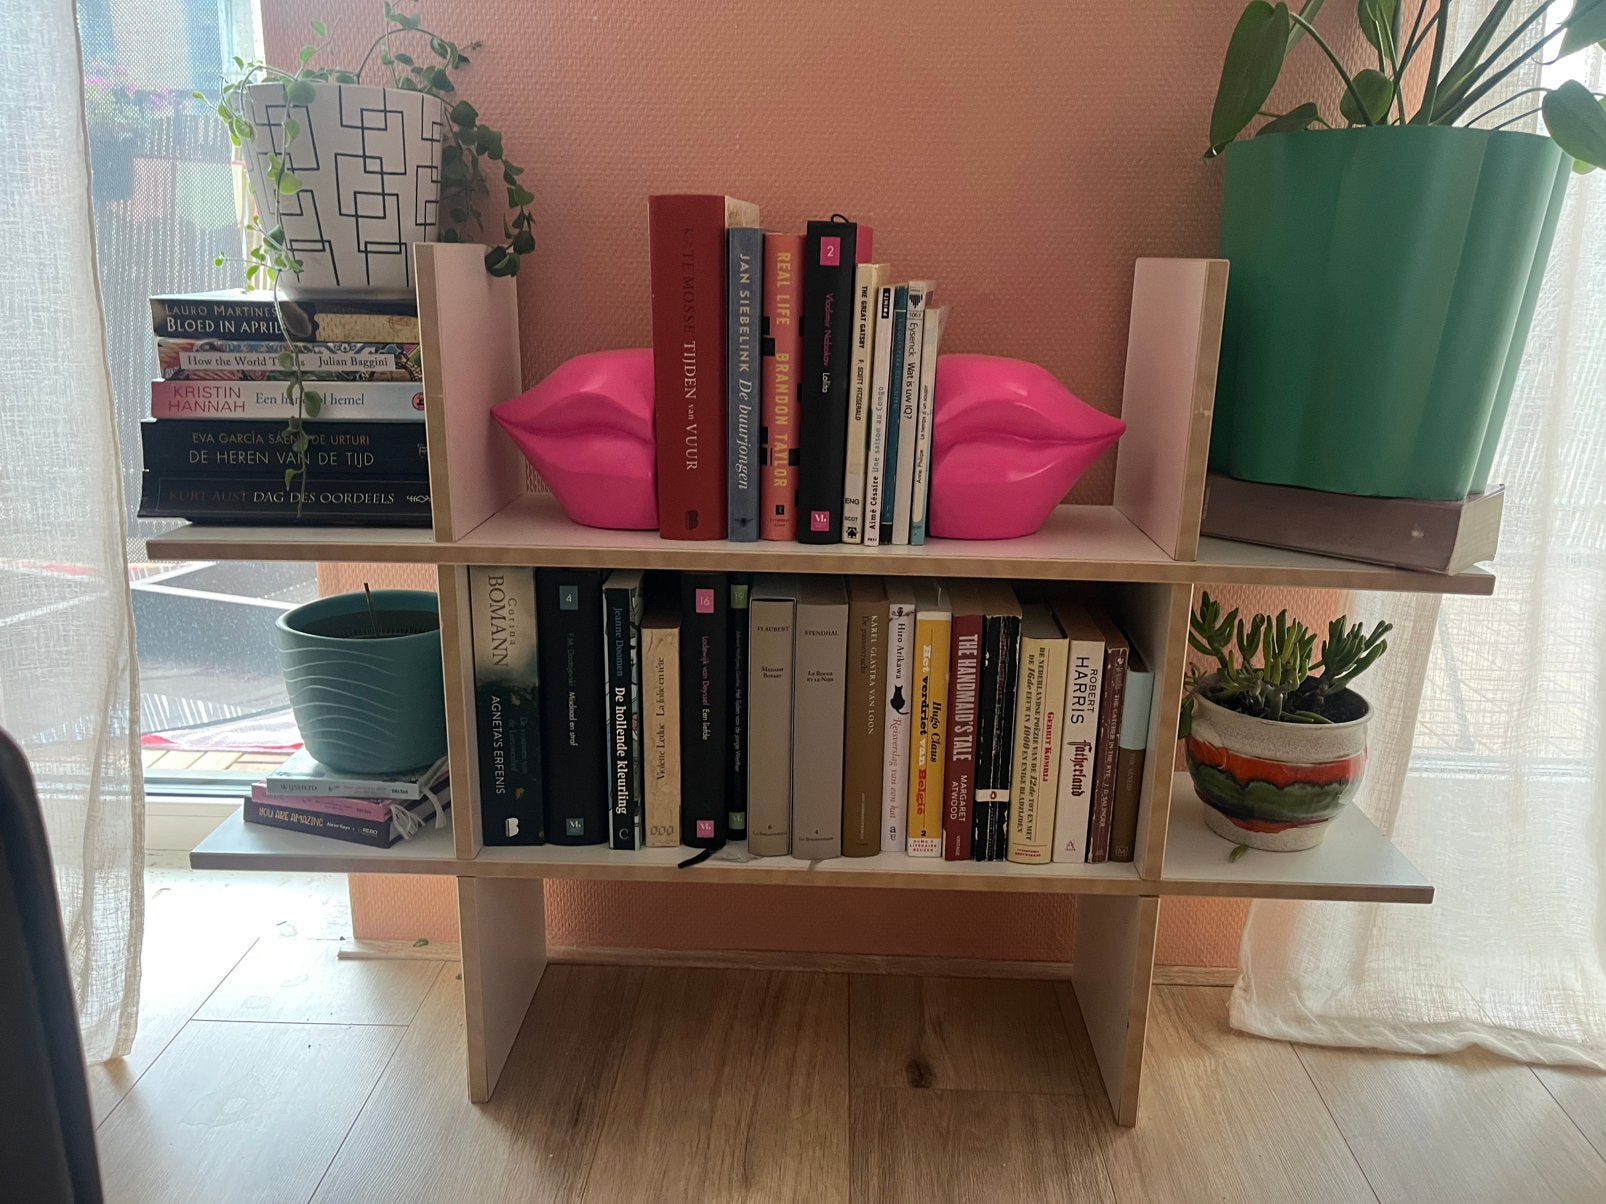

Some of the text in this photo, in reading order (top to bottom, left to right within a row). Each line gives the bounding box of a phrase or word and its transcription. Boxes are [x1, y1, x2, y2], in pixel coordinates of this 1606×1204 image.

[827, 245, 835, 257] 2
[776, 252, 792, 326] REAL LIFE
[165, 304, 207, 316] LAURO
[739, 253, 751, 372] JAN SIEBELINK
[858, 286, 869, 349] THE GREAT GATSBY
[166, 317, 282, 335] BLOED IN APRIL
[908, 322, 919, 357] Eysenck
[188, 355, 206, 367] How
[215, 355, 232, 366] the
[234, 356, 267, 367] World
[318, 356, 348, 369] Julian
[350, 357, 389, 370] Baggini
[906, 362, 916, 379] Wat
[173, 386, 242, 399] KRISTIN
[821, 372, 831, 393] Lolita
[904, 389, 913, 402] uw
[168, 400, 245, 413] HANNAH
[255, 392, 278, 405] Een
[330, 393, 365, 406] hemel
[683, 341, 699, 471] TIJDEN van VUUR
[902, 404, 912, 420] IQ?
[735, 379, 753, 491] De buurjongen
[773, 353, 791, 488] BRANDON TAYLOR
[192, 432, 215, 445] EVA
[218, 431, 265, 445] GARCÍA
[330, 435, 370, 446] URTURI
[189, 450, 375, 468] DE HEREN VAN DE TIJD
[253, 491, 396, 504] DAG DES OORDEELS
[869, 476, 880, 506] Césaire
[869, 509, 878, 530] Aimé
[566, 593, 573, 603] 4
[700, 596, 711, 606] 16
[487, 575, 509, 667] BOMANN
[612, 607, 625, 678] Jeanne Doomen
[895, 622, 906, 680] Hiro Arikawa
[1038, 647, 1047, 659] DE
[922, 644, 932, 674] Het
[1027, 654, 1035, 666] DE
[867, 615, 879, 735] KAREL GLASTRA VAN LOON
[1026, 666, 1036, 691] 16de
[1034, 659, 1046, 717] NEDERLANDSE
[952, 633, 979, 762] THE HANDMAID'S TALE
[1070, 656, 1090, 725] HARRIS
[1086, 669, 1098, 713] ROBERT
[918, 676, 930, 737] verdriet
[702, 708, 711, 740] Een liefde
[929, 701, 942, 764] Hugo Claus
[1044, 711, 1056, 746] GERRIT
[490, 696, 506, 795] AGNETA'S ERFENIS
[615, 687, 630, 815] De hollende kleurling
[888, 718, 902, 767] Reisverslag
[918, 737, 927, 767] van
[949, 781, 959, 821] ATWOOD
[957, 775, 968, 823] MARGARET
[258, 807, 324, 828] YOU ARE AMAZING
